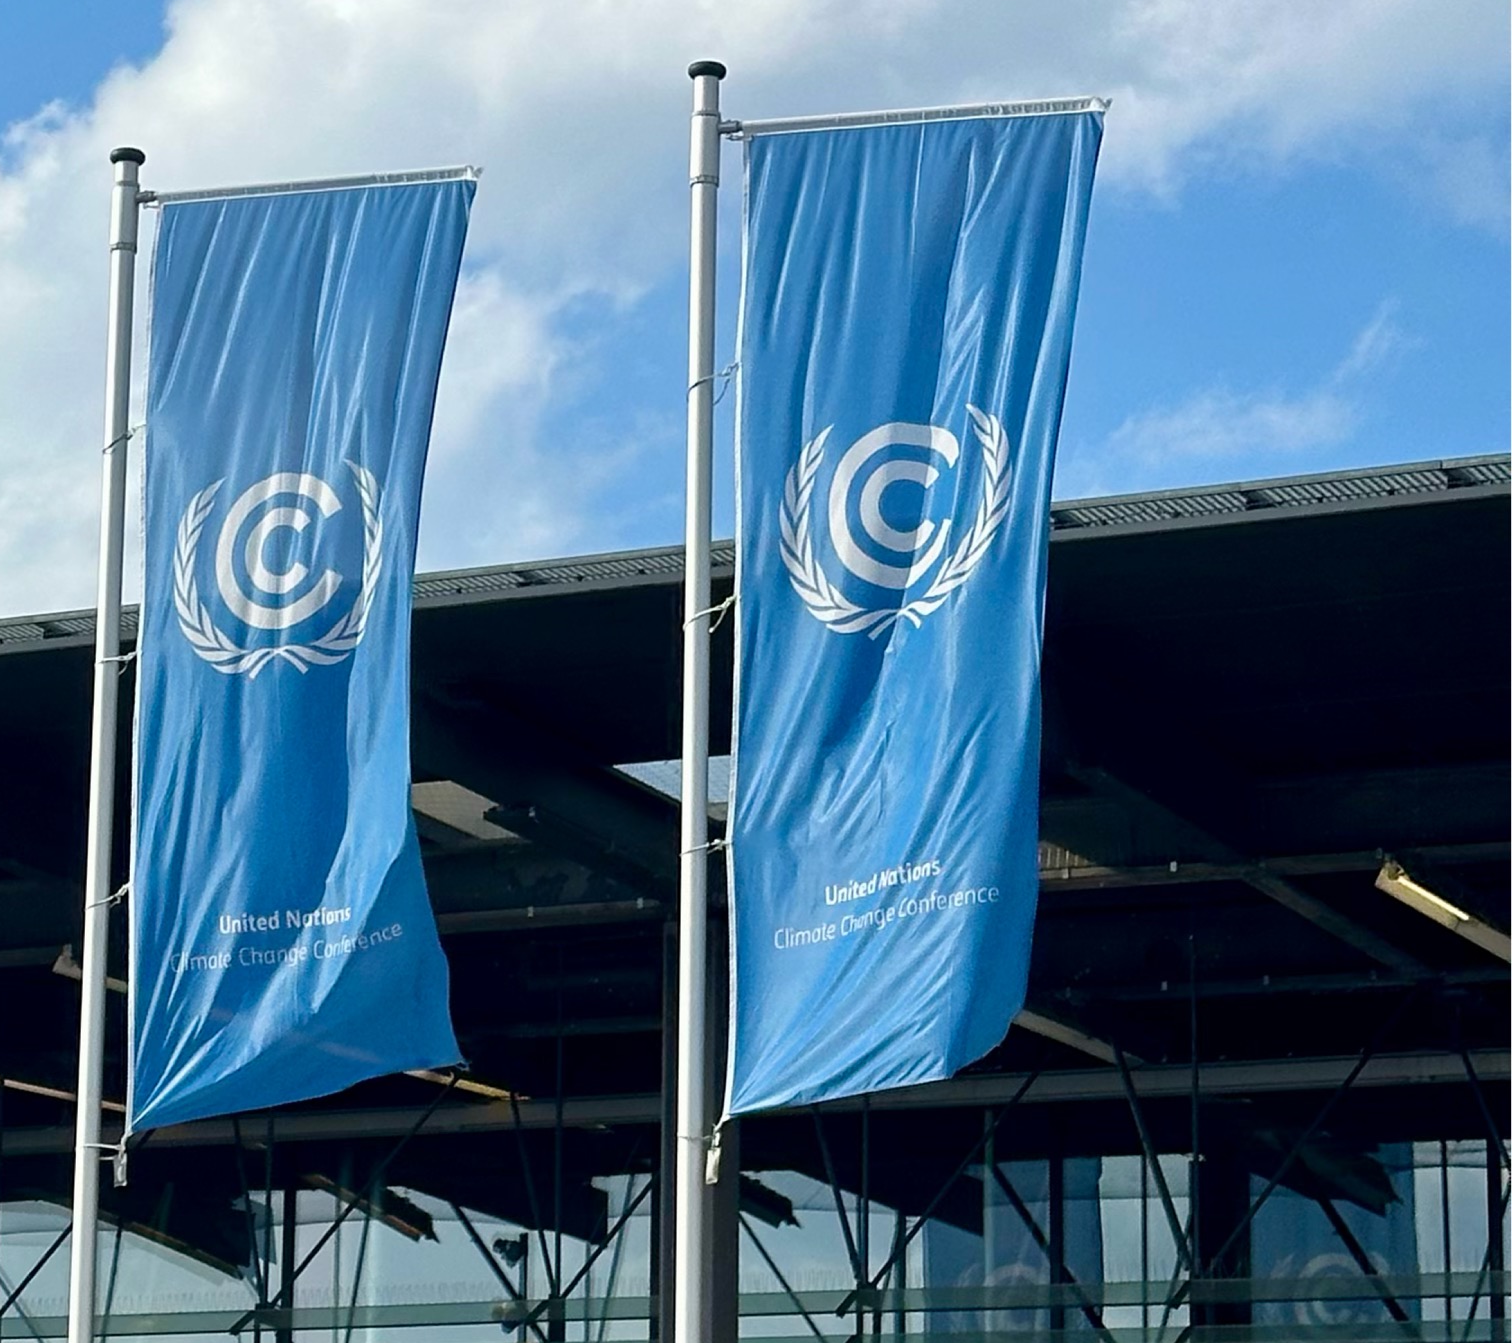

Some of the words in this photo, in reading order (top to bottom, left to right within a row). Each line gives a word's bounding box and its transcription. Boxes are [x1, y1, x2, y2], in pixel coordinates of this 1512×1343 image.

[825, 874, 878, 906] United
[879, 859, 941, 891] Nations
[219, 910, 280, 935] United
[286, 906, 351, 930] Nations
[774, 922, 836, 950] Climate
[841, 905, 896, 936] Change
[898, 885, 1000, 919] Conference
[170, 951, 232, 973] Climate
[239, 946, 308, 967] Change
[313, 921, 403, 960] Conference
